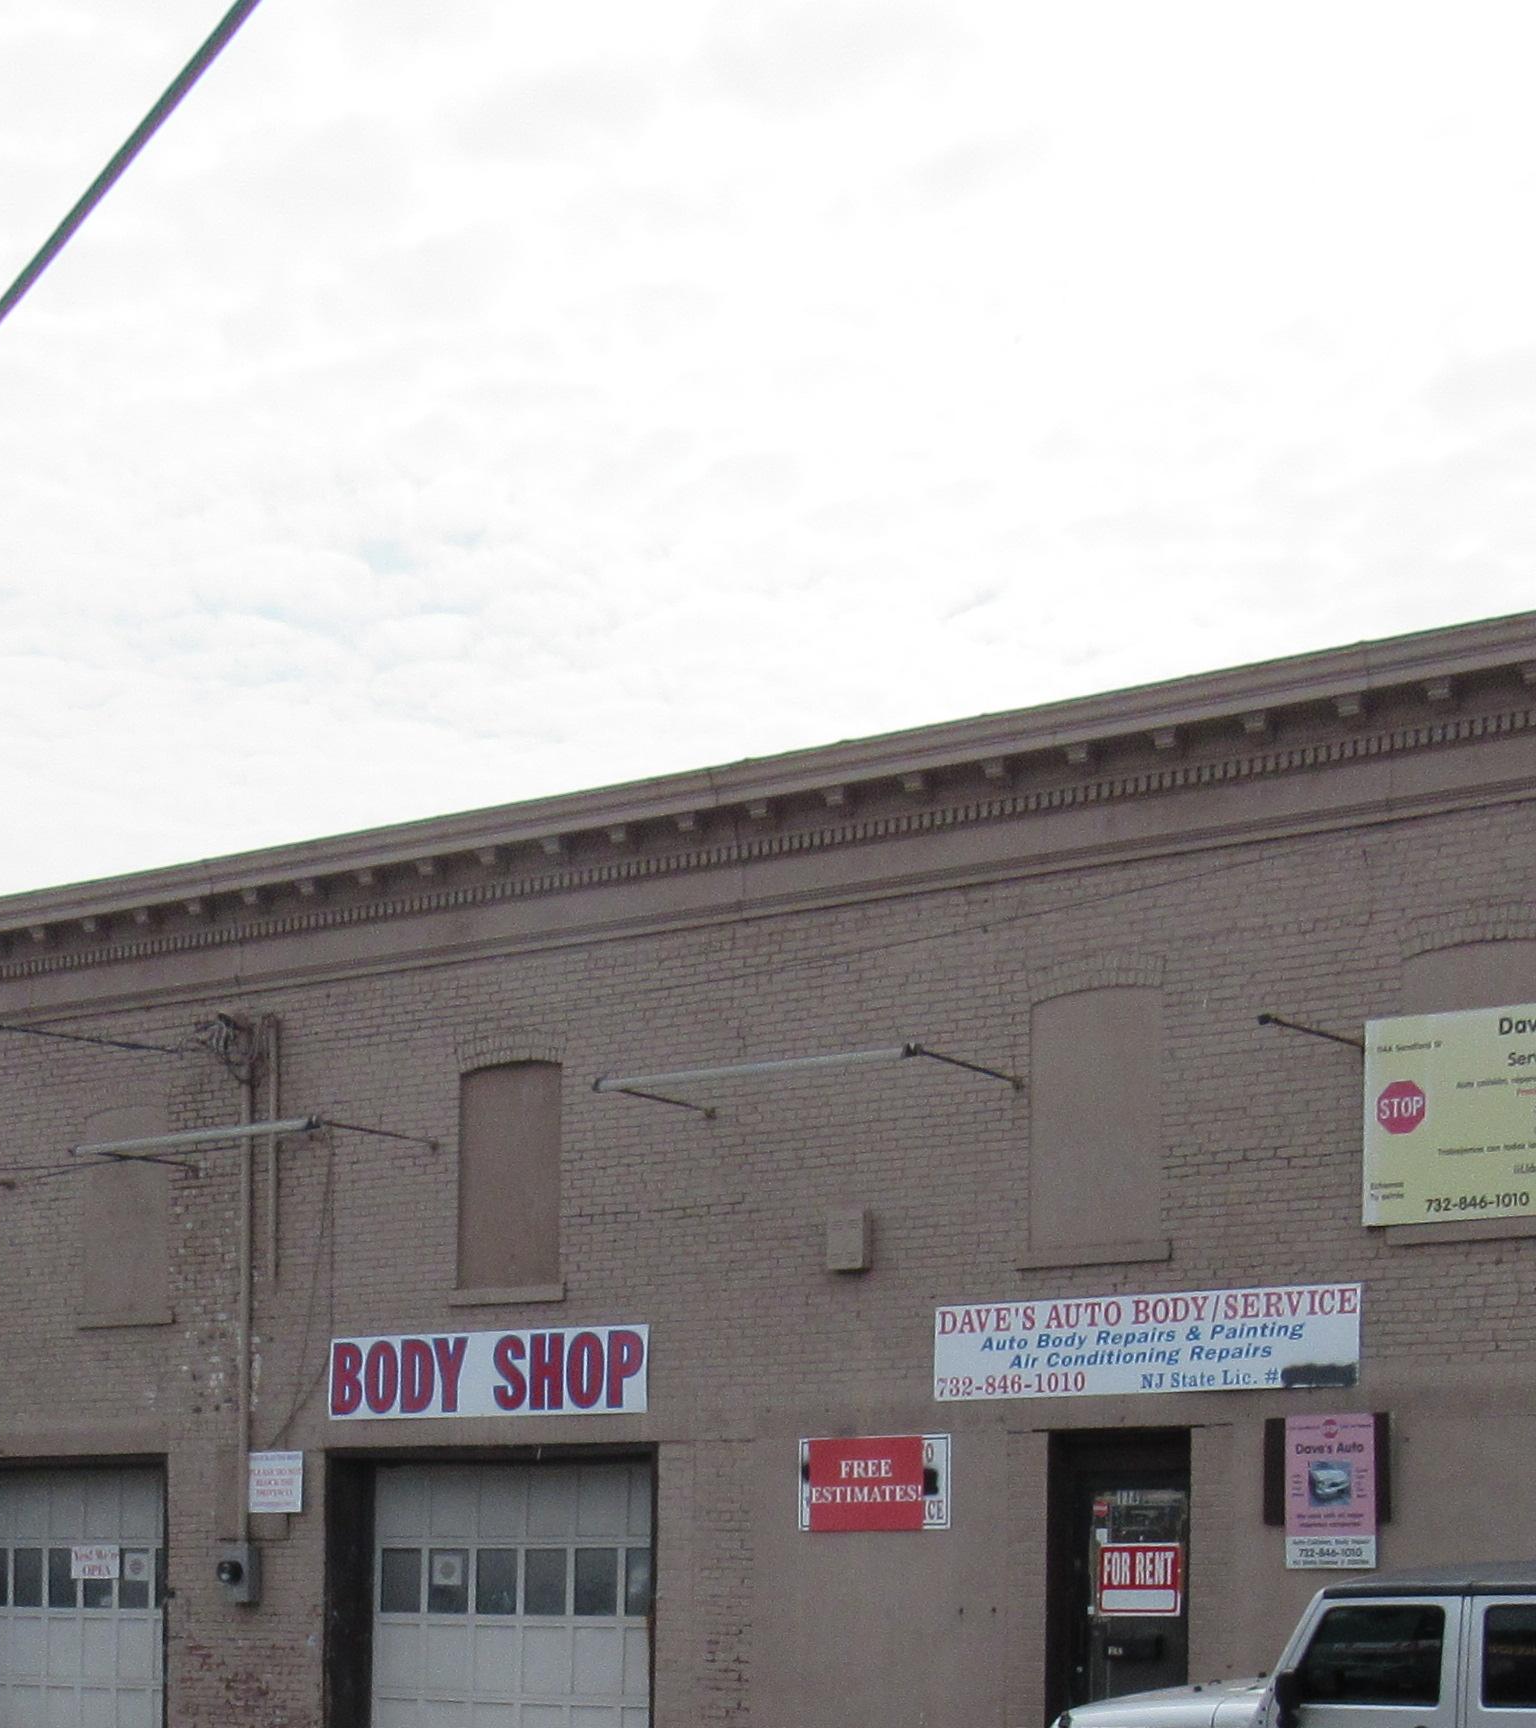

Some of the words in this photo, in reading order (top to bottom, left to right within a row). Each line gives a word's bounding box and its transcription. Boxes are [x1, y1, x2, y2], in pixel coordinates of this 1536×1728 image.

[1379, 1097, 1424, 1119] STOP
[1425, 1191, 1530, 1213] 732-846-1010
[938, 1304, 1036, 1335] DAVE'S
[1045, 1300, 1122, 1330] AUTO
[1132, 1287, 1358, 1324] BODY/SERVICE
[980, 1336, 1029, 1352] Auto
[1037, 1332, 1088, 1350] Body
[1096, 1329, 1175, 1348] Repairs
[1185, 1325, 1202, 1342] &
[1210, 1321, 1306, 1341] Painting
[1009, 1353, 1039, 1369] Air
[1047, 1347, 1181, 1368] Conditioning
[1189, 1342, 1273, 1363] Repairs
[331, 1336, 469, 1416] BODY
[493, 1329, 645, 1411] SHOP
[937, 1371, 1086, 1398] 732-846-1010
[1141, 1373, 1165, 1389] NJ
[1170, 1370, 1216, 1388] State
[1221, 1369, 1258, 1386] Lic.
[1336, 1442, 1364, 1454] Auto
[839, 1459, 893, 1479] FREE
[810, 1484, 923, 1504] ESTIMATES!
[1103, 1551, 1131, 1586] FOR
[1135, 1551, 1175, 1586] RENT
